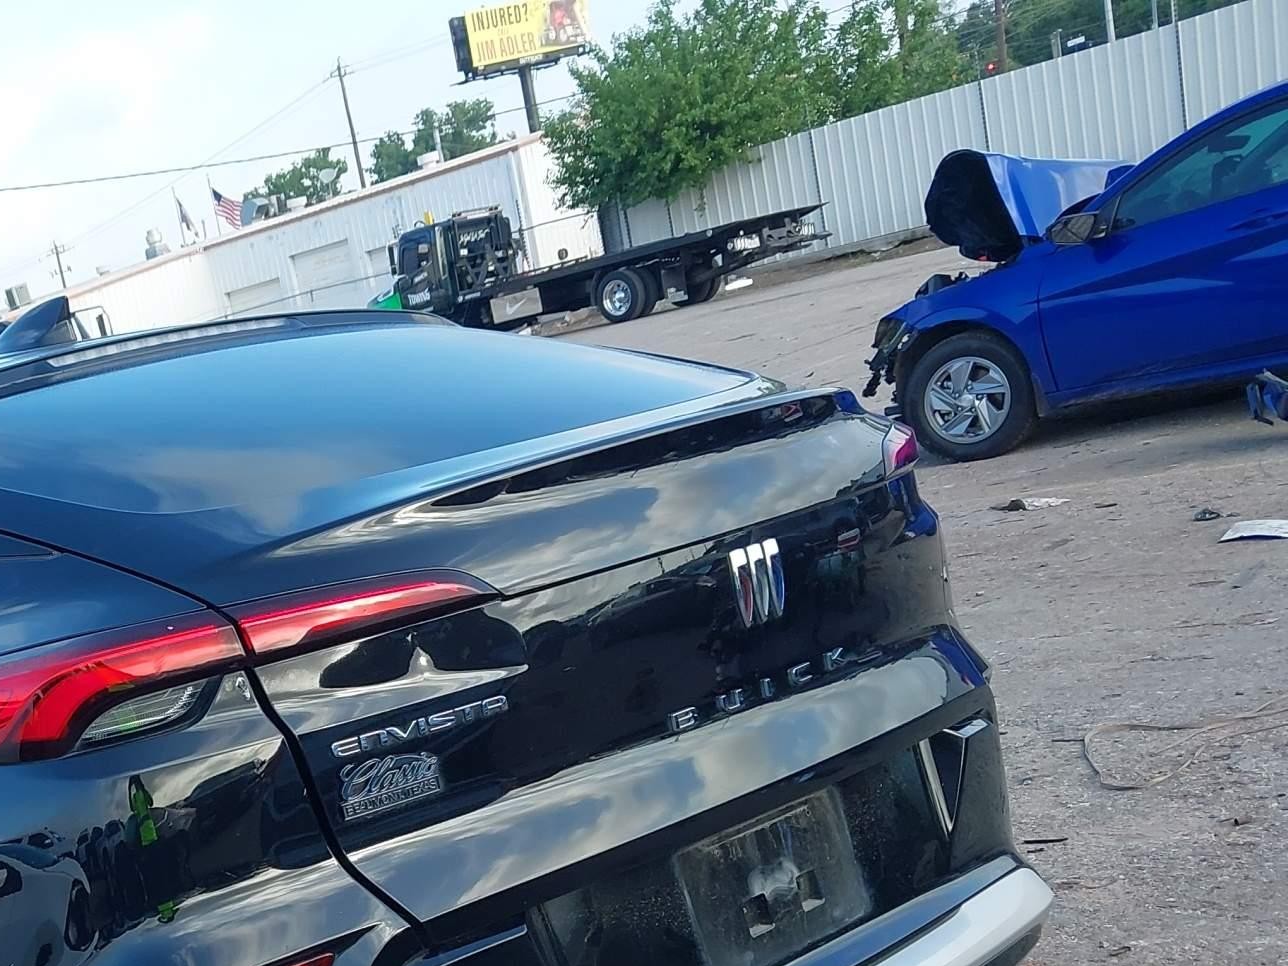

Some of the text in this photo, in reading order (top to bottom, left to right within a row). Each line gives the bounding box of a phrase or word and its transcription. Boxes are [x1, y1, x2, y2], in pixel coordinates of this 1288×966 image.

[471, 3, 529, 32] INJURED?
[476, 39, 497, 62] JIM
[500, 32, 537, 57] ADLER
[668, 647, 846, 732] BUICK
[330, 695, 510, 758] ENVISTA
[340, 752, 439, 802] Classic
[406, 778, 438, 799] TEXAS
